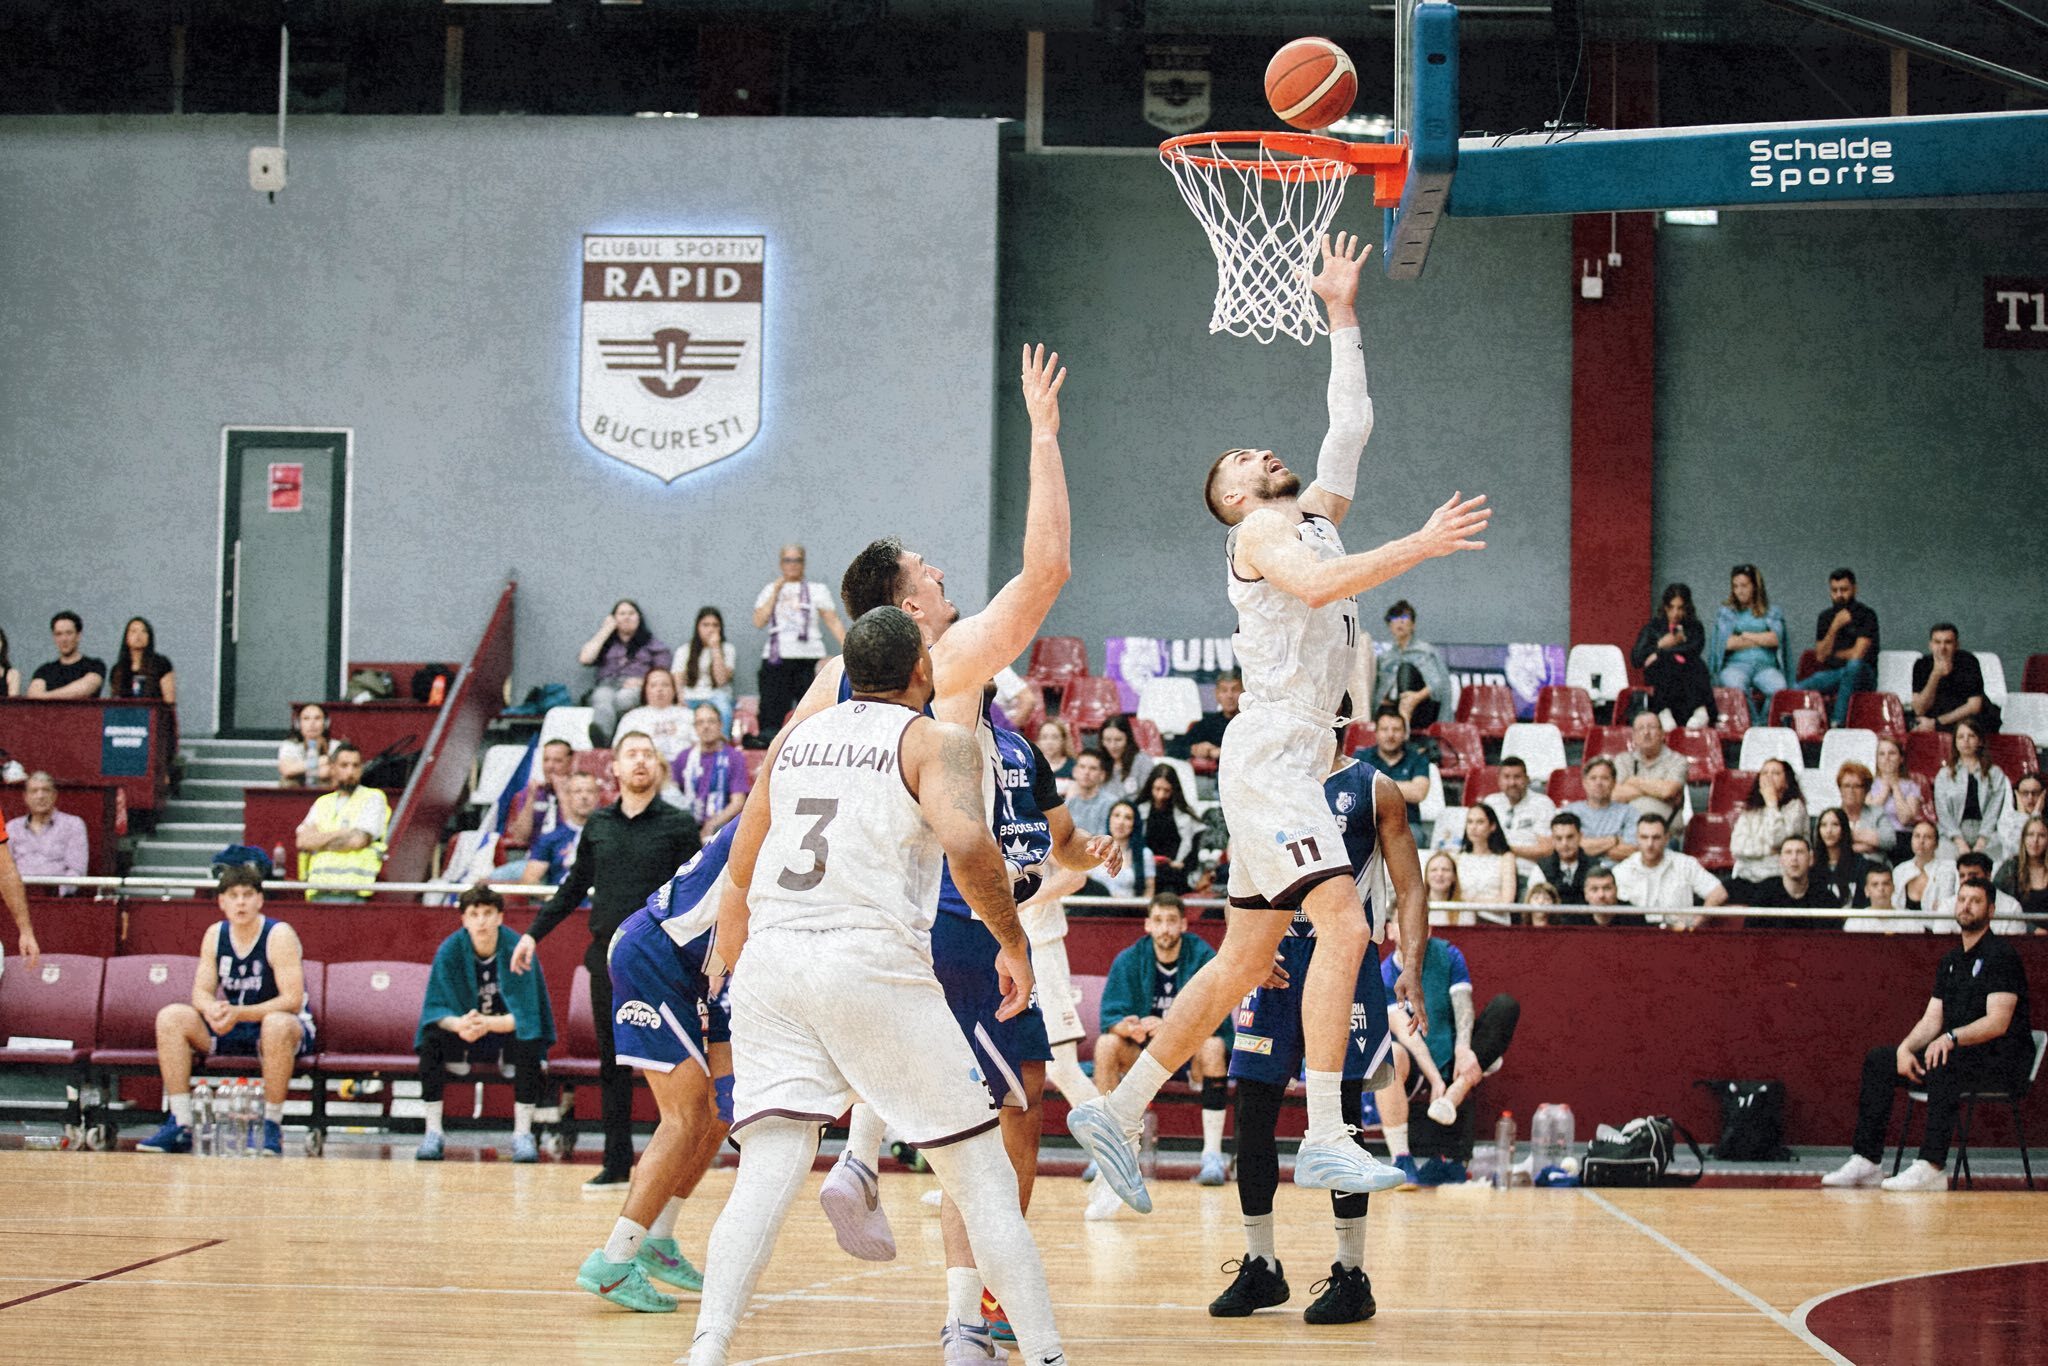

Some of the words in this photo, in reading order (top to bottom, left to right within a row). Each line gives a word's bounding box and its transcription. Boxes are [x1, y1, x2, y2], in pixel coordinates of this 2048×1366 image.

[1750, 137, 1892, 162] Schelde
[1750, 162, 1895, 192] Sports
[588, 241, 661, 257] CLUBUL
[675, 241, 759, 257] SPORTIV
[603, 266, 742, 298] RAPID
[593, 414, 745, 451] BUCURESTI
[778, 743, 896, 774] SULLIVAN
[777, 797, 839, 891] 3
[1286, 836, 1322, 868] 11
[616, 1006, 661, 1029] prima
